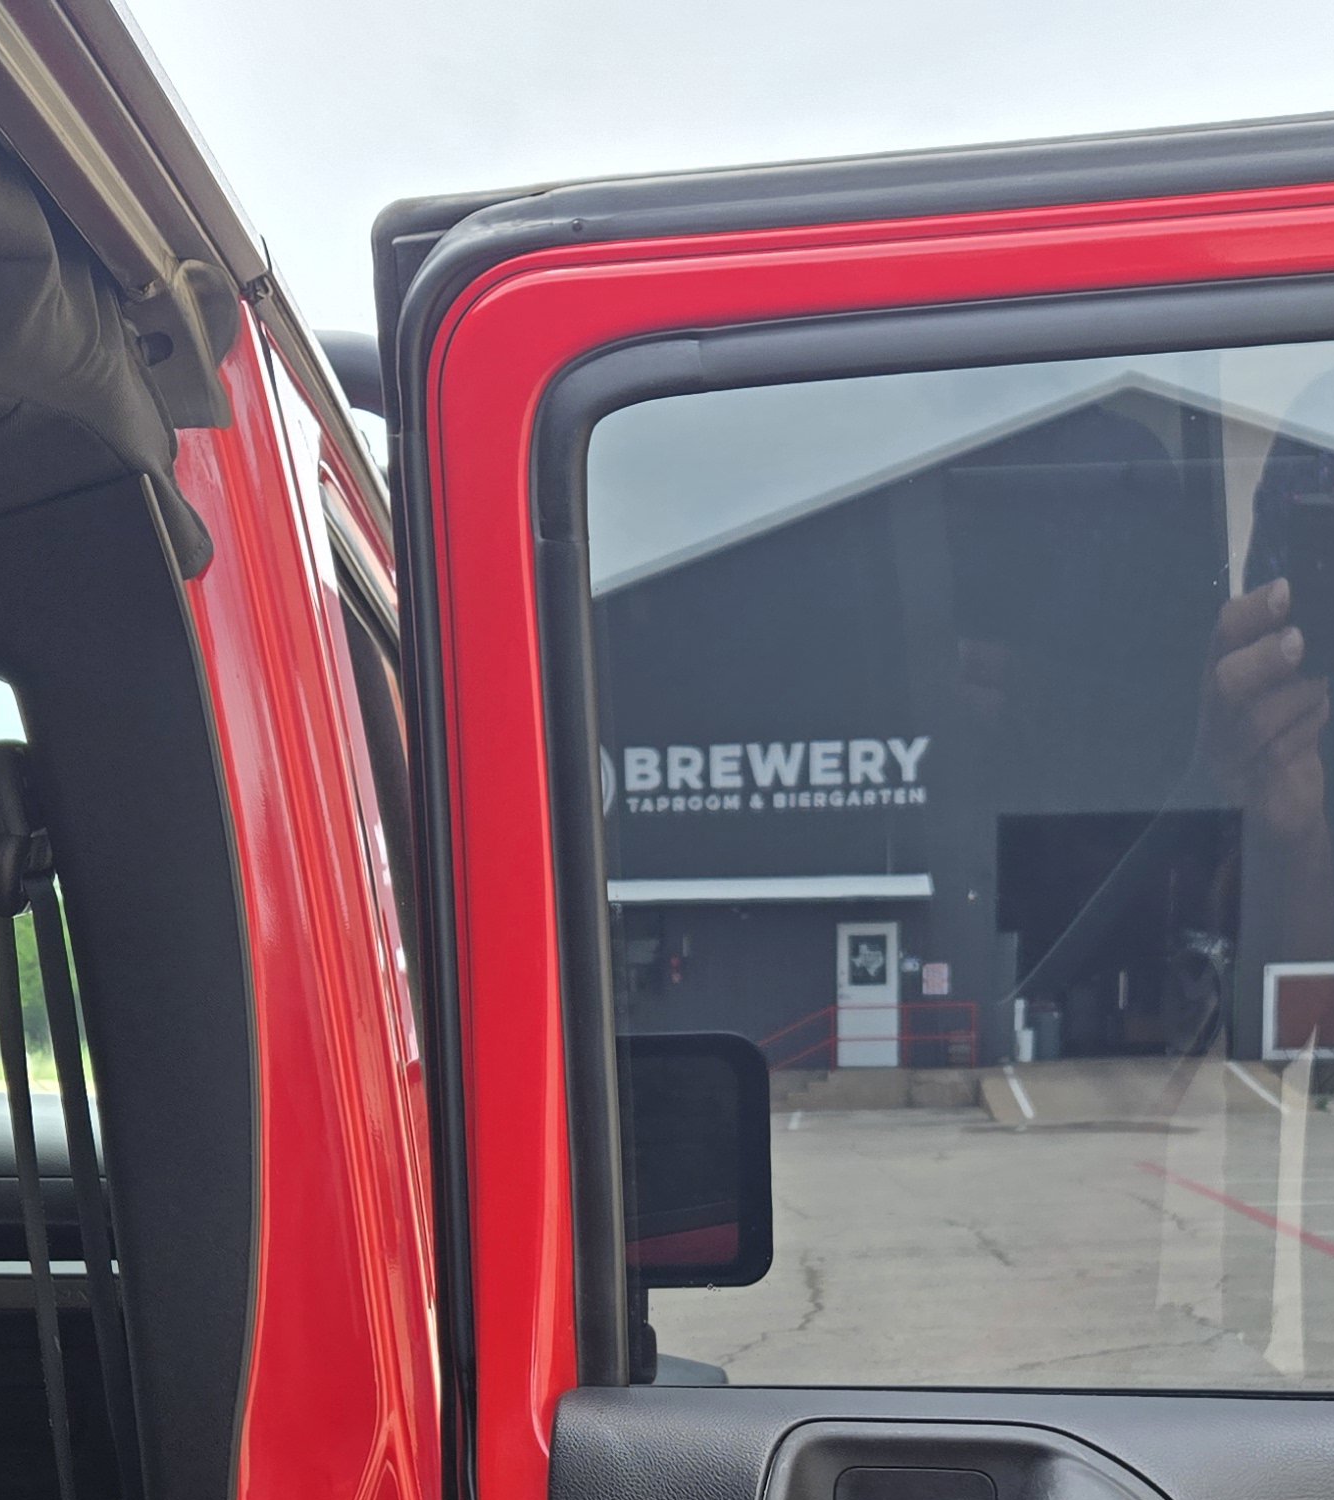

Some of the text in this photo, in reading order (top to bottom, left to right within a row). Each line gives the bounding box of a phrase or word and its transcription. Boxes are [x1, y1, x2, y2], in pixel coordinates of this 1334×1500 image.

[624, 737, 930, 792] BREWERY
[625, 787, 927, 814] TAPROOM & BIERGARTEN
